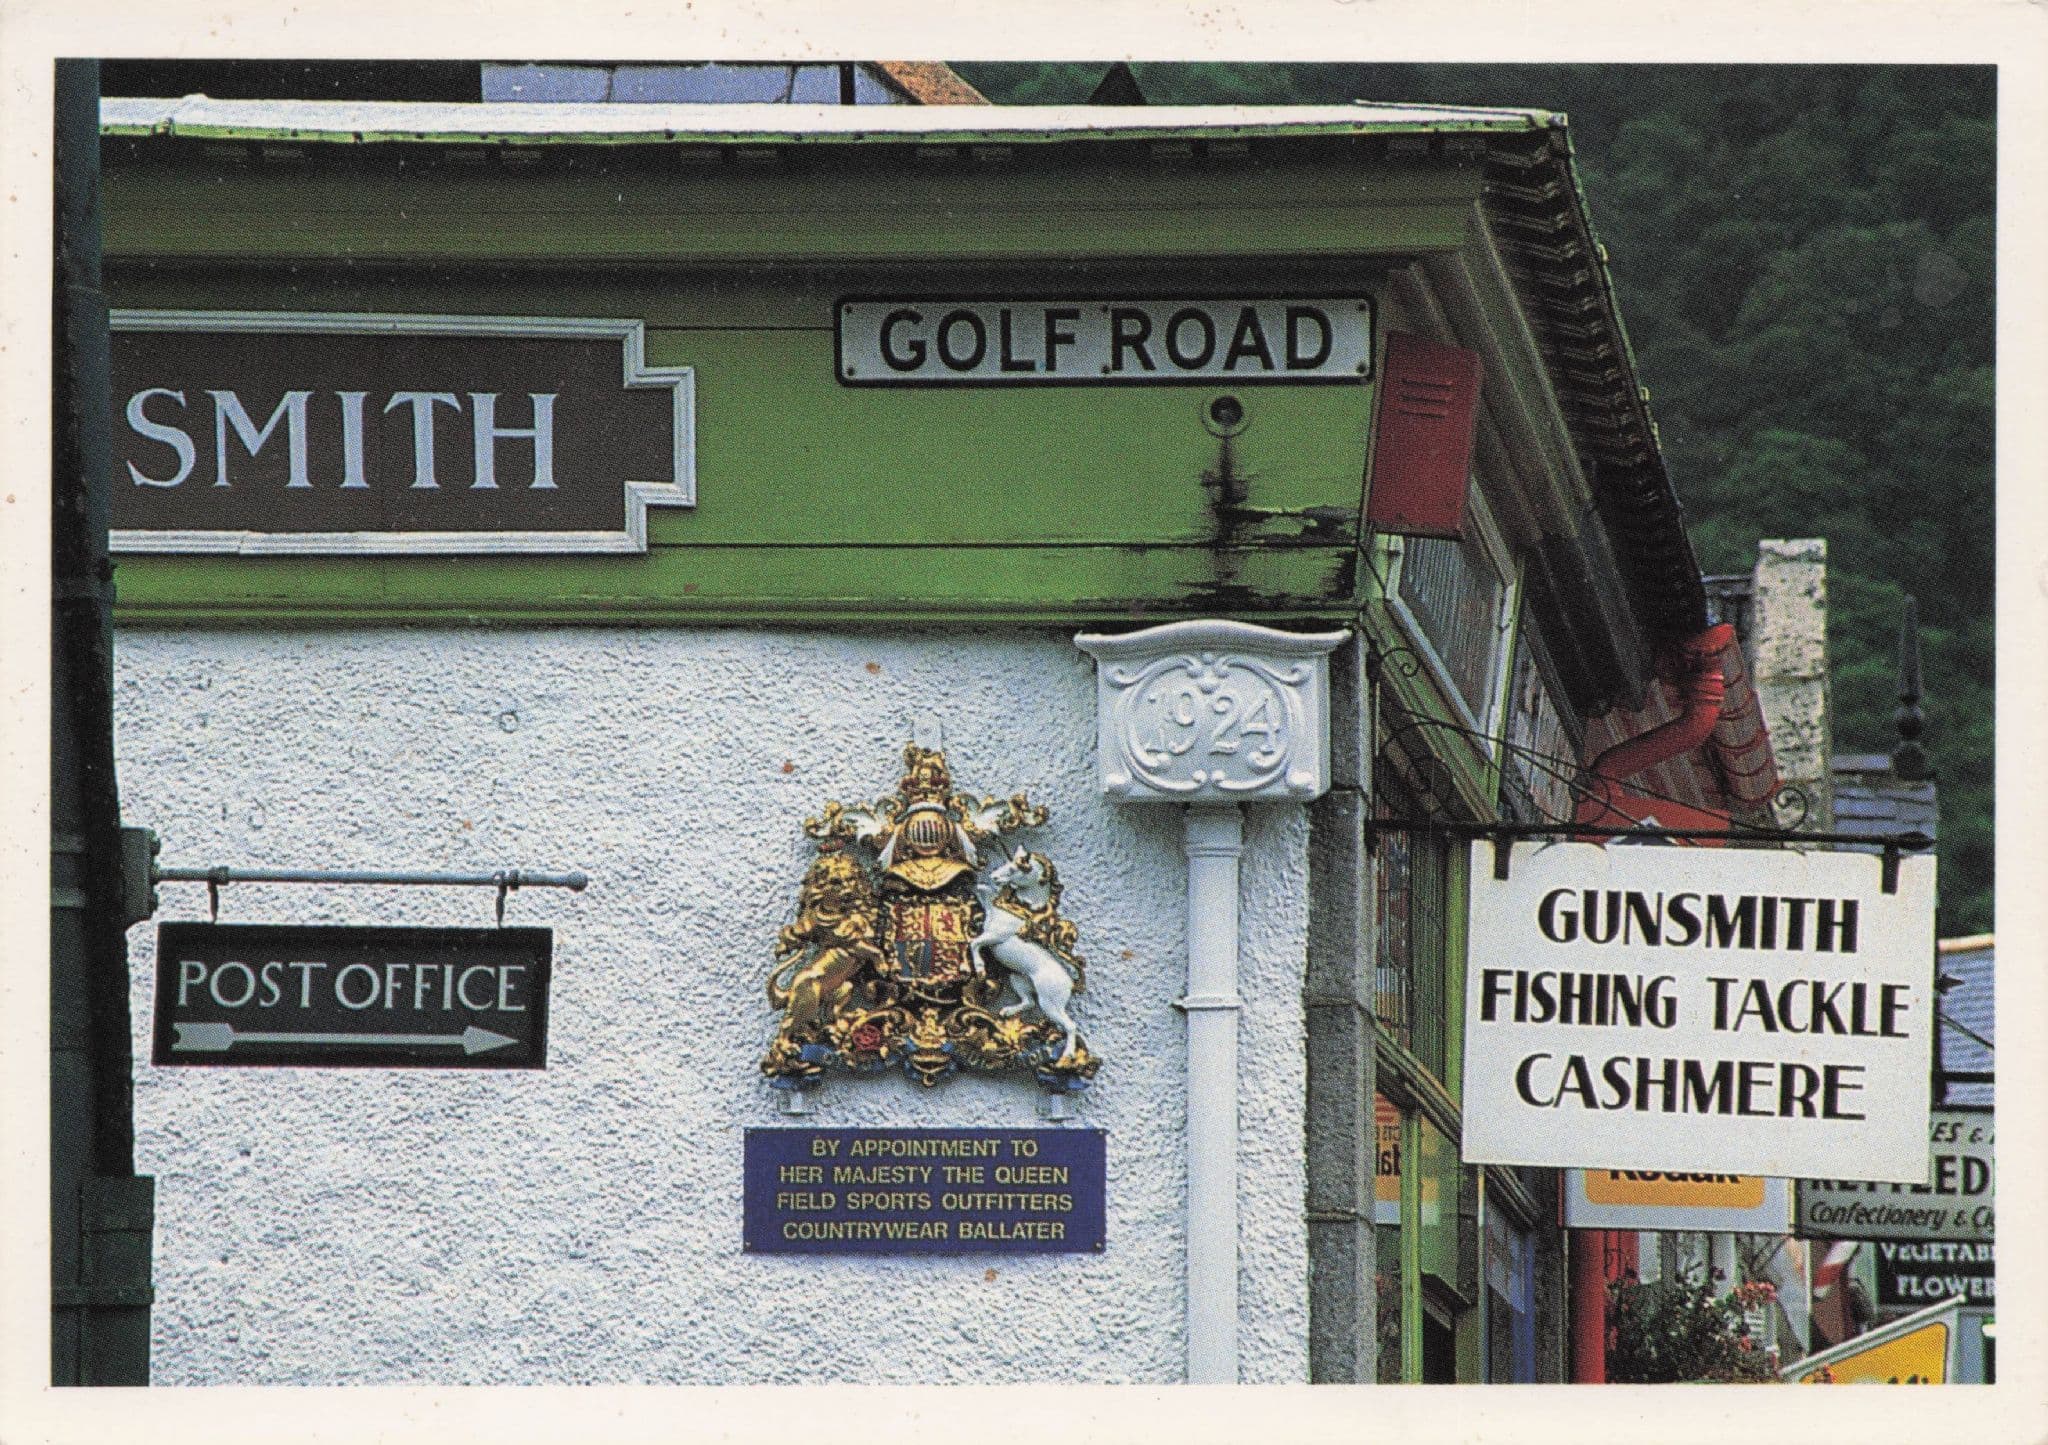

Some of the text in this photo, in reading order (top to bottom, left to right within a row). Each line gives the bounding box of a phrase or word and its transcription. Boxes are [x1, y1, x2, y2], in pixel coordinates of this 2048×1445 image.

[880, 305, 1334, 373] GOLF ROAD
[126, 388, 559, 489] SMITH
[1146, 683, 1281, 757] 1924
[1538, 888, 1859, 953] GUNSMITH
[177, 961, 526, 1011] POST OFFICE
[1481, 969, 1911, 1038] FISHING TACKLE
[1515, 1053, 1866, 1121] CASHMERE
[812, 1139, 1038, 1158] BY APPOINTMENT TO
[780, 1166, 1069, 1186] HER MAJESTY THE QUEEN
[777, 1192, 1073, 1212] FIELD SPORTS OUTFITTERS
[1810, 1201, 1947, 1231] Confectionery
[783, 1221, 1066, 1240] COUNTRYWEAR BALLATER
[1880, 1242, 1995, 1262] VEGETAB
